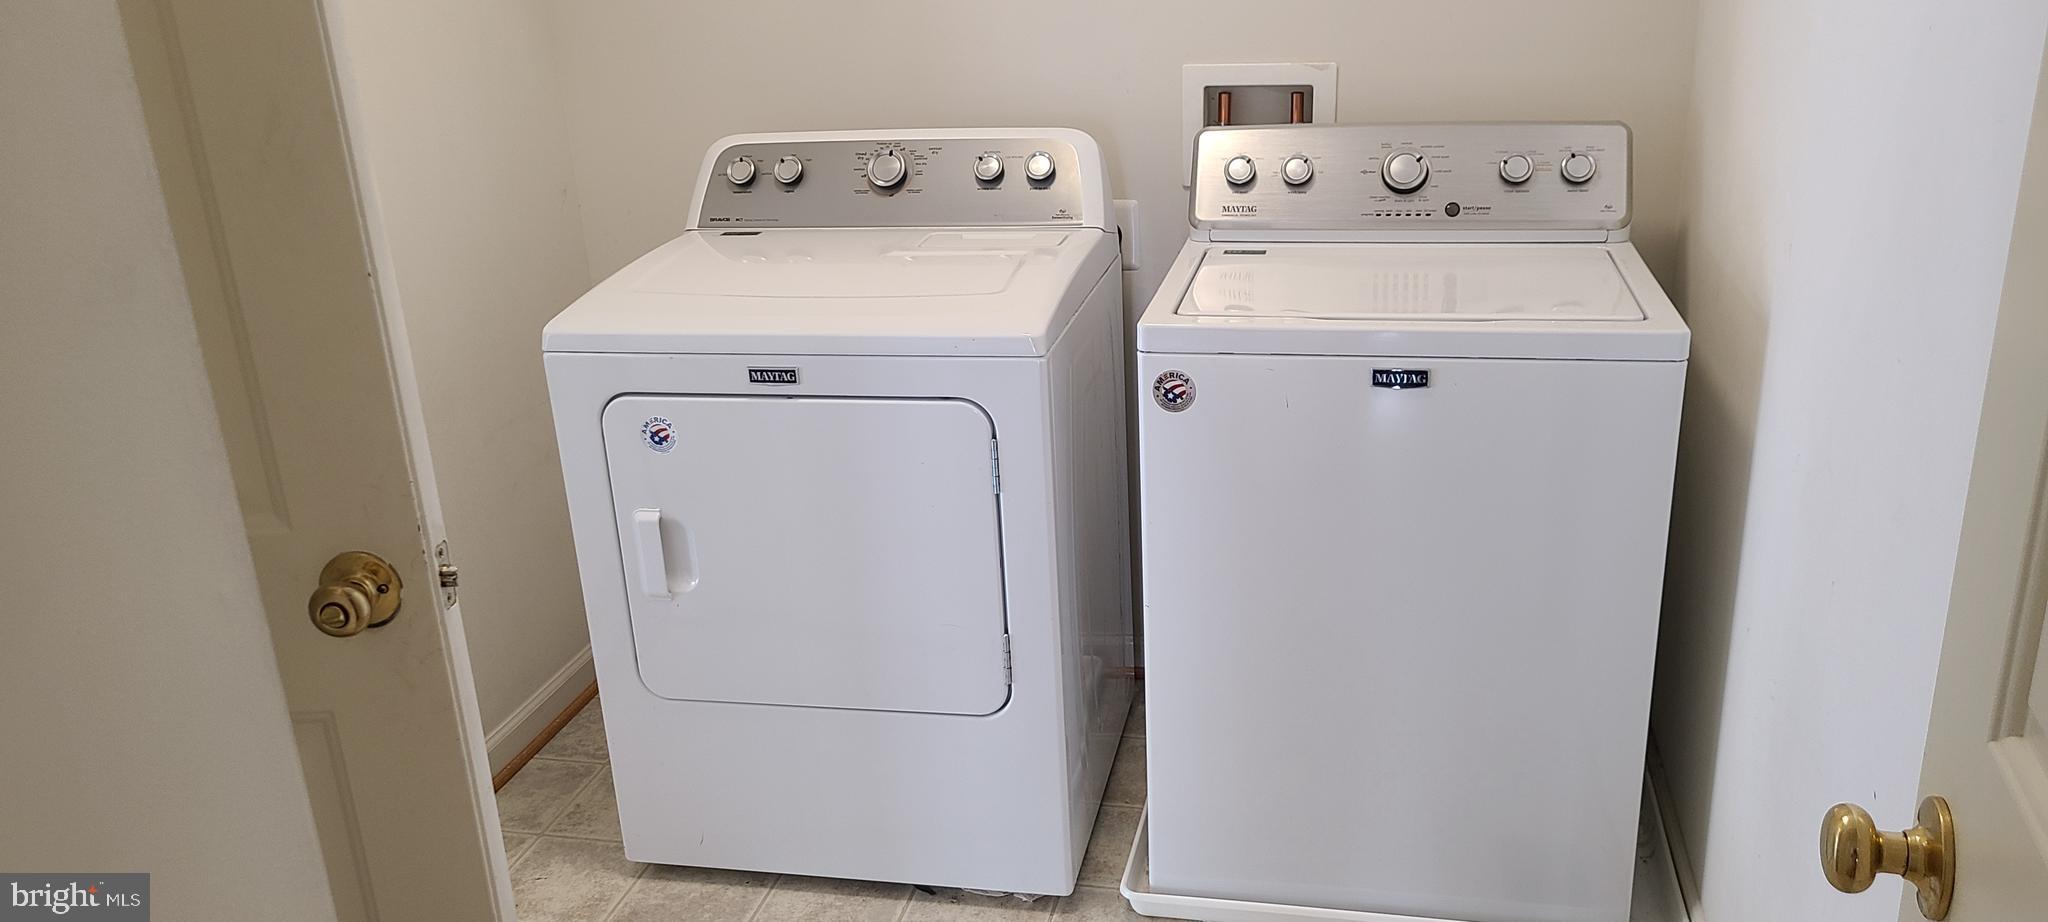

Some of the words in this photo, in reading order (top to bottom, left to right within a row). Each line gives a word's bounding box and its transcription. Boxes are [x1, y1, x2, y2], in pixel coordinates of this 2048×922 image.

[1222, 205, 1257, 213] MAYTAG
[751, 371, 796, 382] MAYTAG
[1154, 372, 1190, 392] AMERICA
[1374, 373, 1427, 384] MAYTAG
[641, 416, 673, 435] AMERICA
